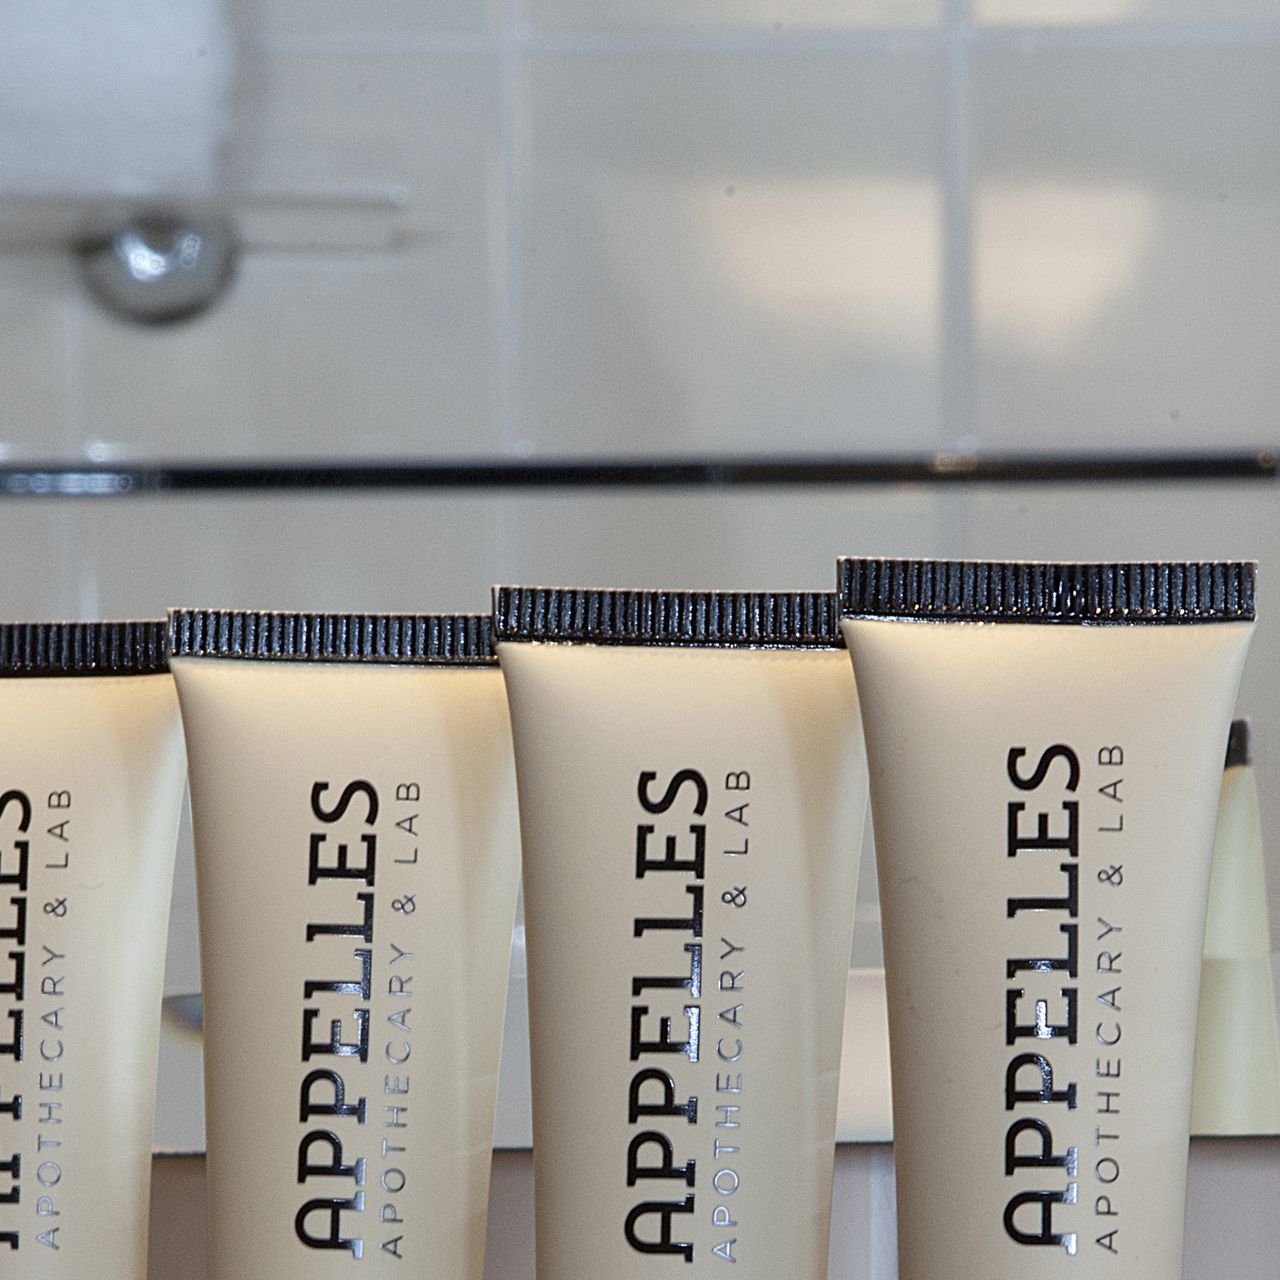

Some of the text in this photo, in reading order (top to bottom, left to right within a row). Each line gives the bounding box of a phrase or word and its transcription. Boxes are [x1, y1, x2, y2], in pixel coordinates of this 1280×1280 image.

[35, 790, 72, 1251] APOTHECARY & LAB
[294, 778, 379, 1259] APPELLES
[379, 782, 421, 1259] APOTHECARY & LAB
[624, 768, 709, 1263] APPELLES
[712, 770, 751, 1263] APOTHECARY & LAB
[1003, 743, 1081, 1256] APPELLES
[1095, 745, 1125, 1254] APOTHECARY & LAB
